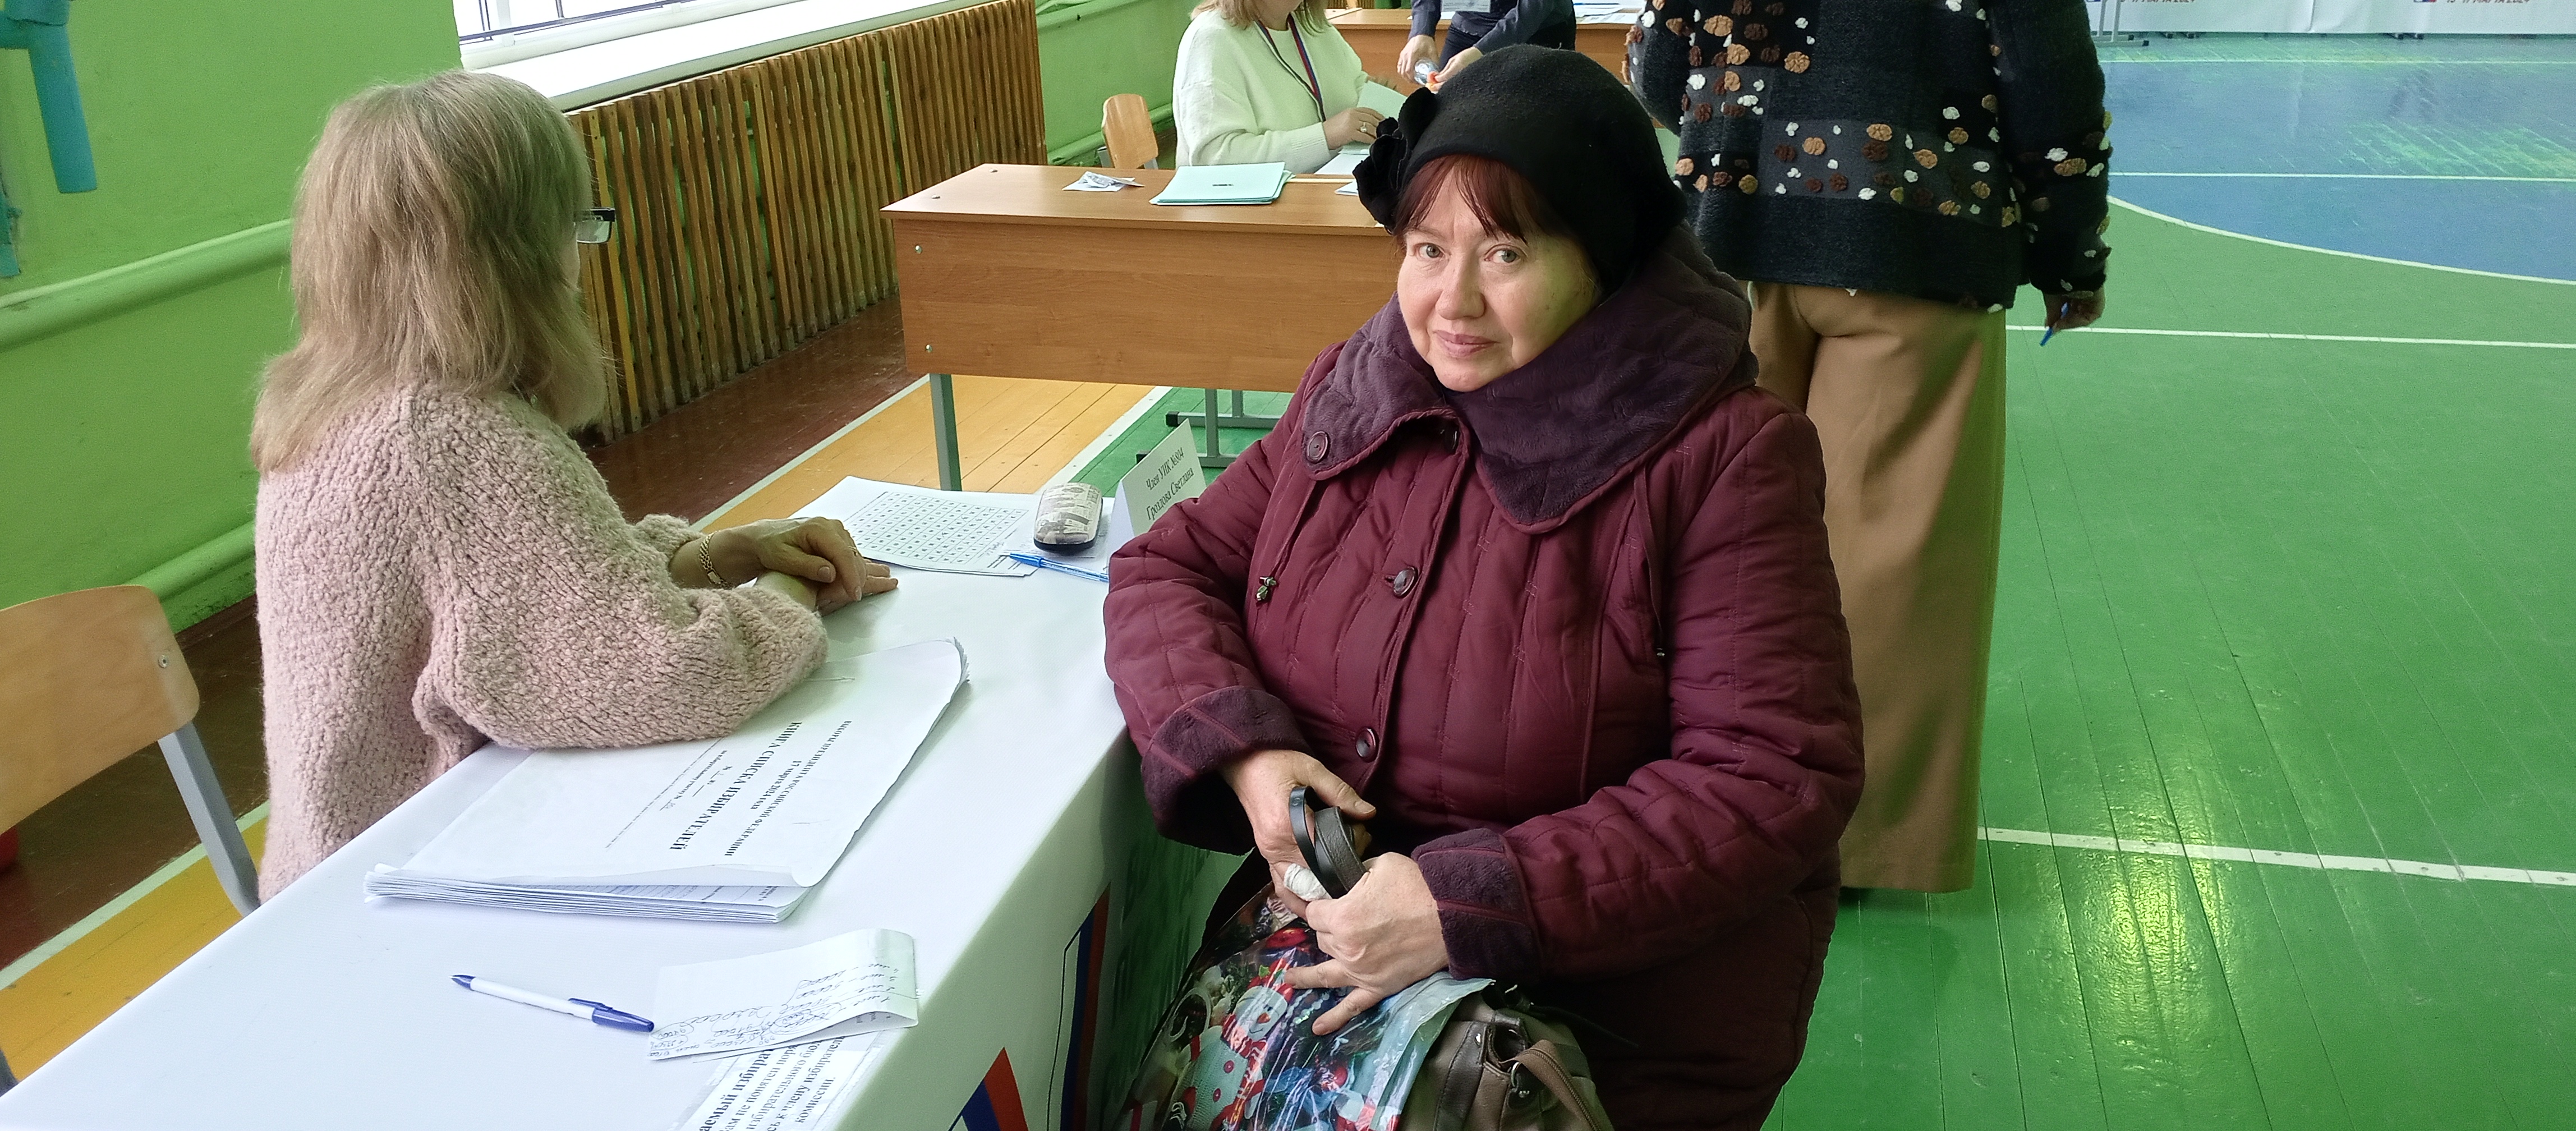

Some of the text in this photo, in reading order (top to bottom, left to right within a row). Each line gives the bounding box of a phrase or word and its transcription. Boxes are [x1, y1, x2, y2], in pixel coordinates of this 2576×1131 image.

[1146, 474, 1160, 490] Член
[1158, 459, 1171, 479] УИК
[1171, 467, 1194, 495] Светлана
[769, 721, 802, 748] КНИГА
[733, 751, 774, 784] СПИСКА
[775, 768, 794, 784] марта
[724, 721, 852, 856] ВЫБОРЫ ПРЕЗИДЕНТА РОССИЙСКОЙ ФЕДЕРАЦИИ
[750, 798, 766, 810] года
[763, 785, 780, 797] 2024
[669, 787, 742, 850] ИЗБИРАТЕЛЕЙ
[735, 1104, 751, 1116] не
[746, 1068, 780, 1102] понятен
[746, 1059, 806, 1129] избирательного
[781, 1085, 810, 1112] члену
[795, 1077, 835, 1123] комиссии.
